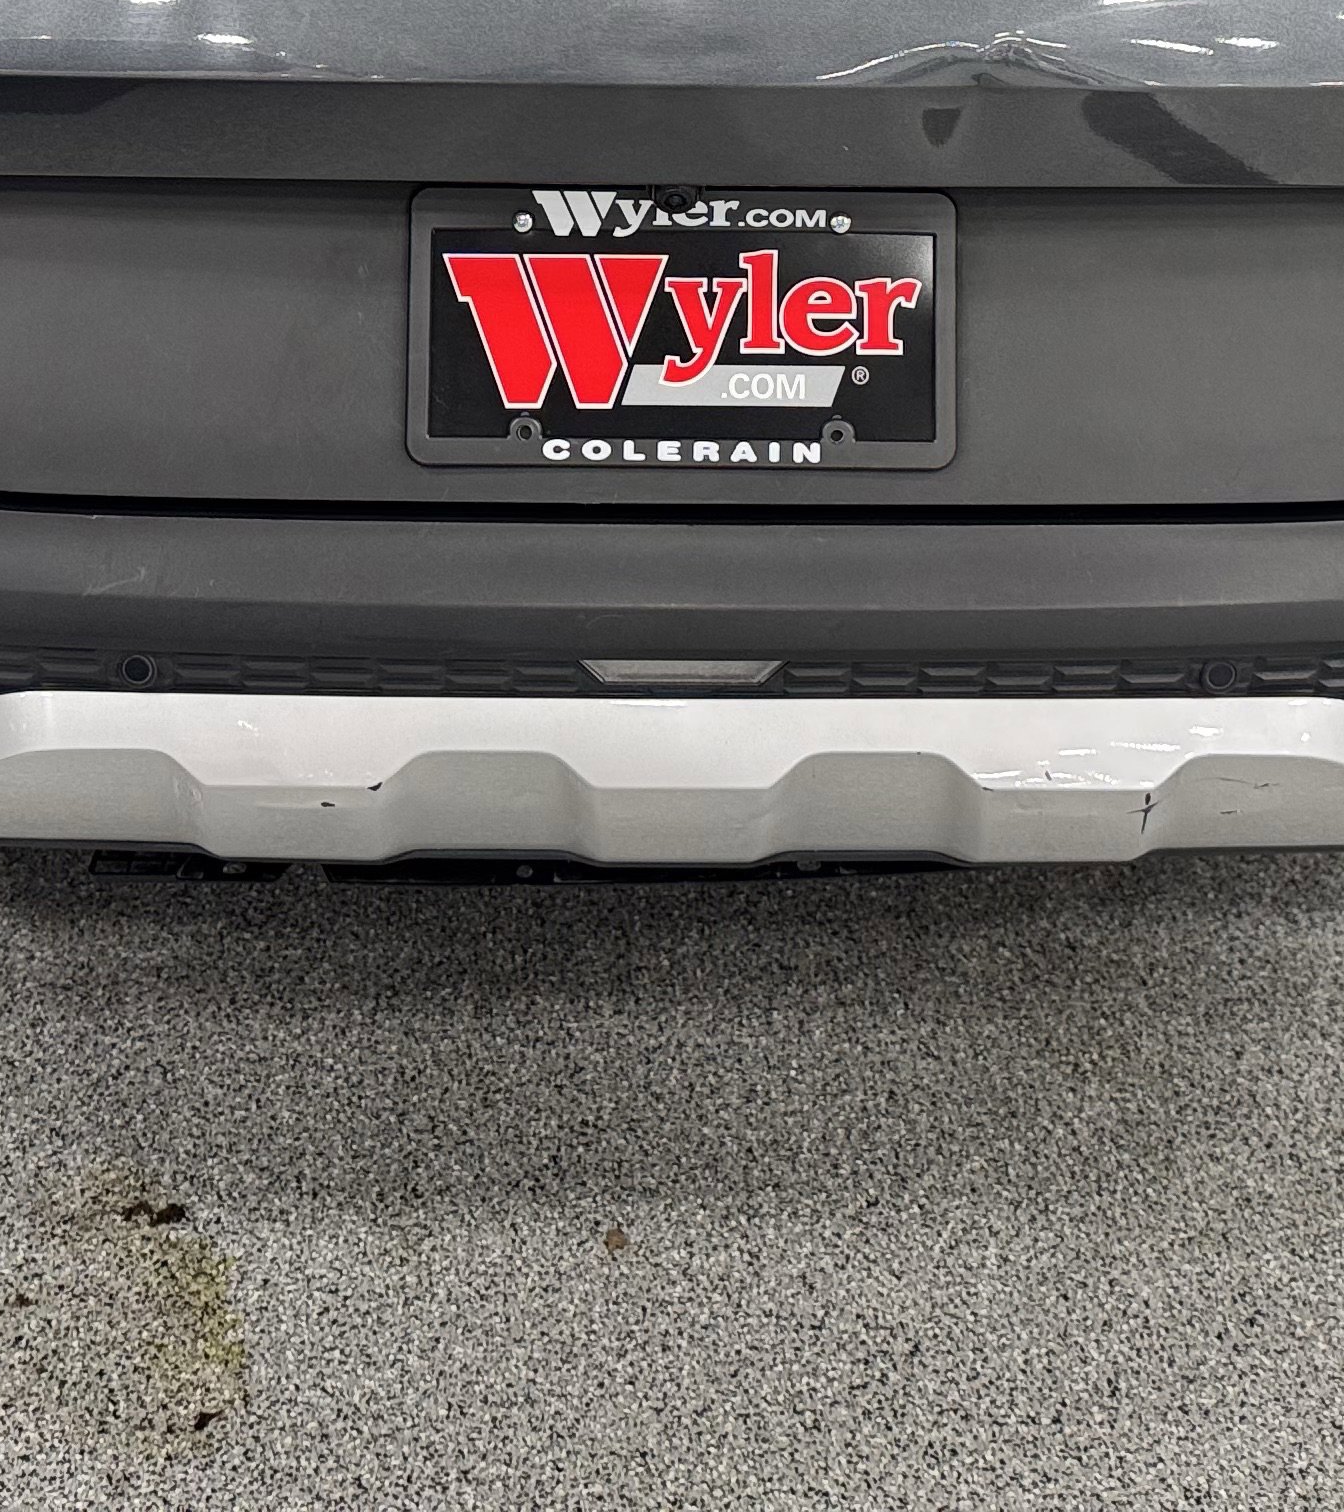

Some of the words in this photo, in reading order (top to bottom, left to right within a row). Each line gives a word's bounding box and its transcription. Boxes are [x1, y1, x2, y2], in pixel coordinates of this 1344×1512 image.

[442, 249, 922, 409] Wyler
[721, 373, 806, 400] .COM
[542, 439, 822, 464] COLERAIN
